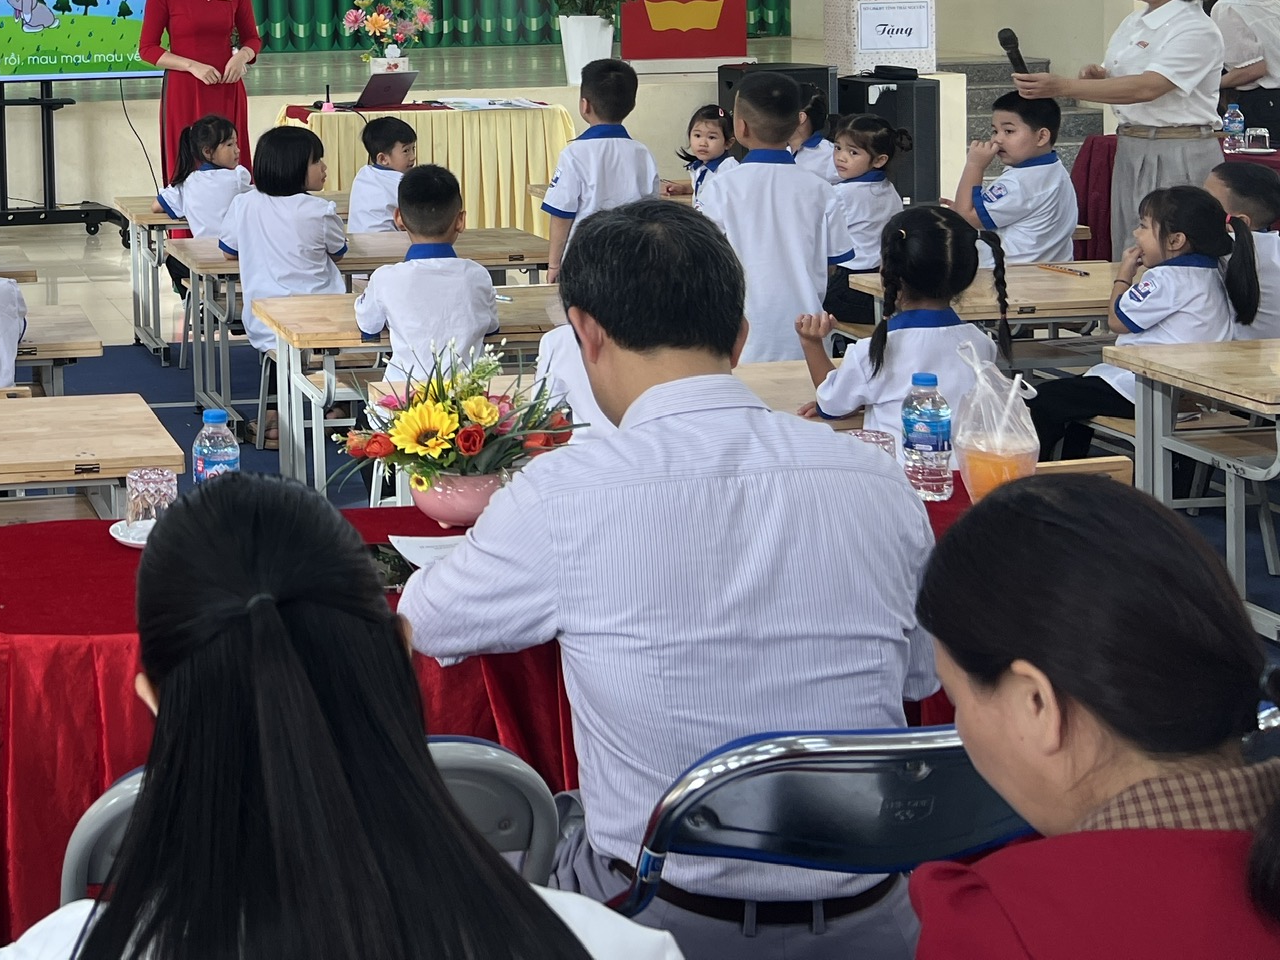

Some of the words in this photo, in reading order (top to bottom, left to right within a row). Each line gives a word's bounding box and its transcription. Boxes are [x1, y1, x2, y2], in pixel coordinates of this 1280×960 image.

[875, 23, 913, 38] Tặng
[4, 52, 24, 67] rồi,
[27, 55, 58, 65] mau
[61, 54, 90, 65] mau
[94, 53, 124, 64] mau
